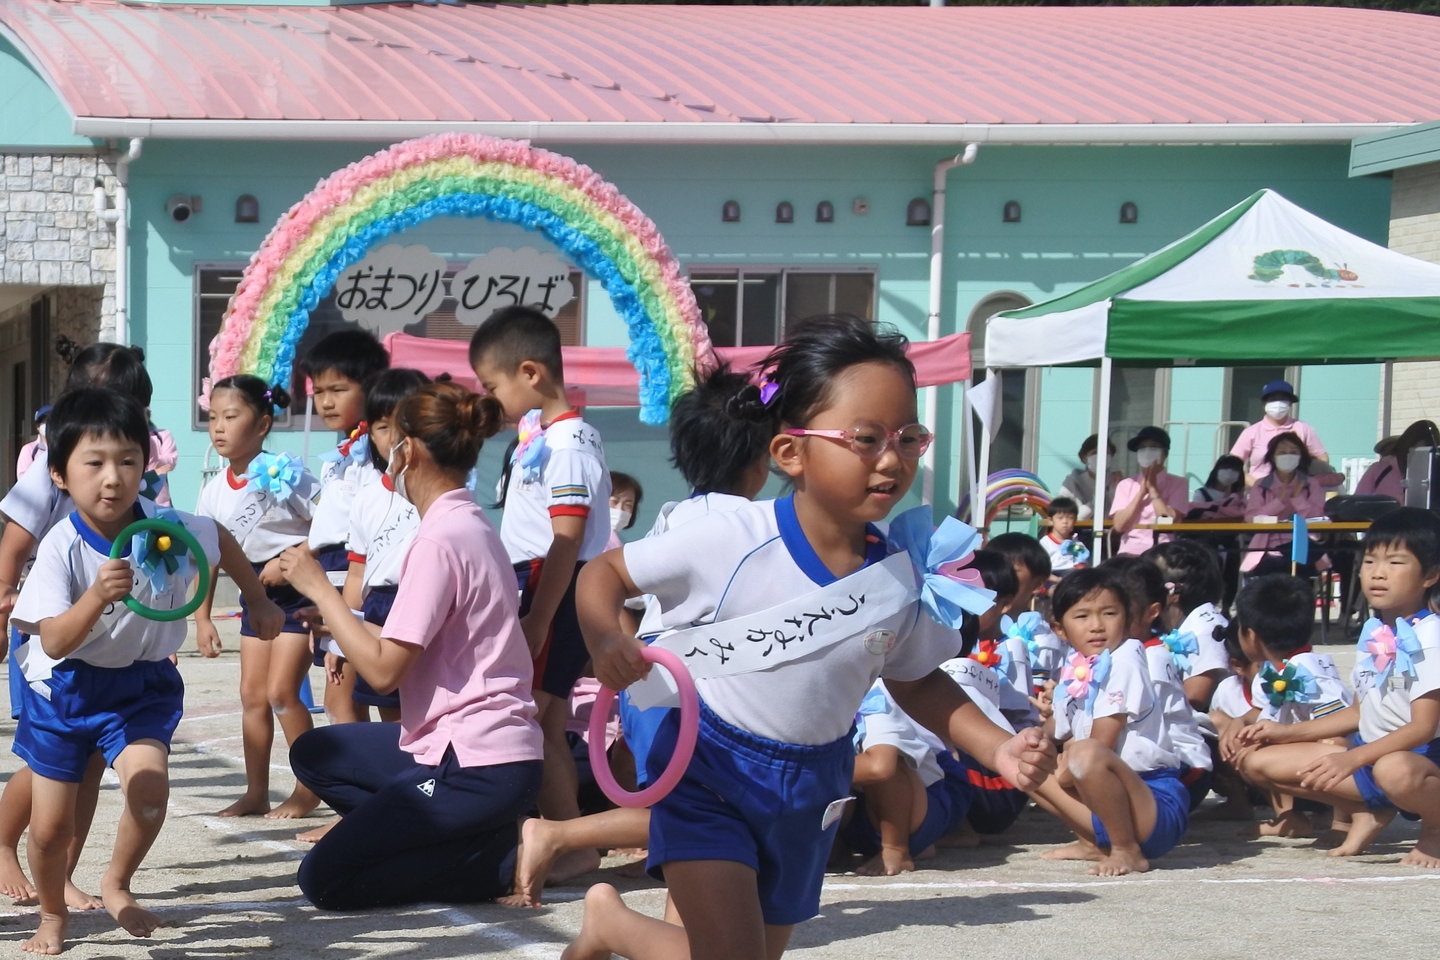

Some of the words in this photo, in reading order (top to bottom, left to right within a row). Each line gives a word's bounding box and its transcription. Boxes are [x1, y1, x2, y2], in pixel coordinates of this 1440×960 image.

[337, 265, 441, 315] おまつり
[462, 273, 565, 312] ひろば
[684, 594, 866, 665] うえなかみく
